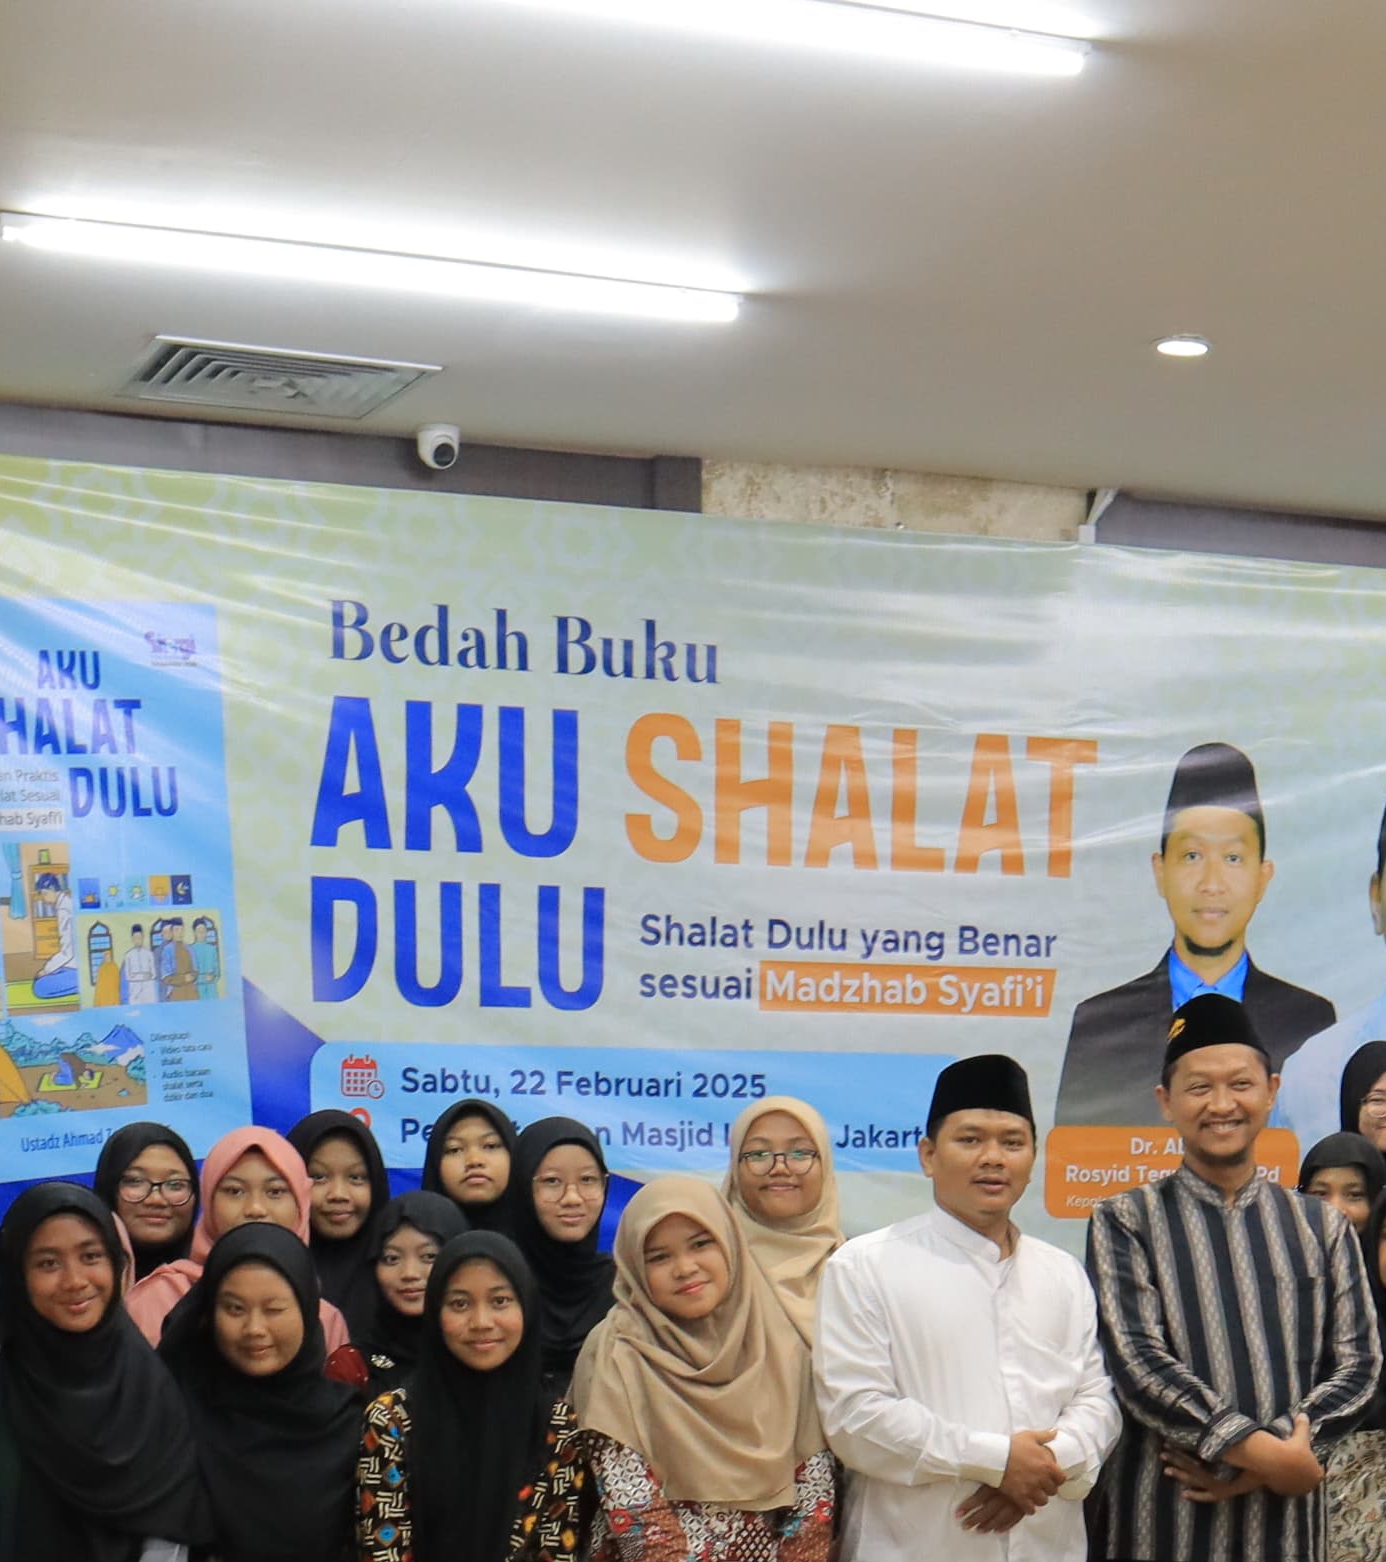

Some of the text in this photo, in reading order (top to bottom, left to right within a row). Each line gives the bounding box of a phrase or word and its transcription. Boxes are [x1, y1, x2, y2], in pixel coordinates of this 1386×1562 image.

[327, 599, 720, 685] Bedah Buku
[37, 649, 102, 690] AKU
[14, 769, 59, 783] Praktis
[68, 766, 180, 819] DULU
[309, 695, 1099, 879] AKU SHALAT
[19, 787, 61, 802] Sesuai
[310, 875, 607, 1012] DULU
[639, 914, 1058, 960] Shalat Dulu yang Benar
[639, 968, 754, 1001] sesuai
[765, 968, 928, 1007] Madzhab
[400, 1066, 767, 1099] Sabtu, 22 Februari 2025
[20, 1134, 60, 1152] Ustadz
[62, 1128, 103, 1146] Ahmad
[621, 1121, 714, 1153] Masjid
[835, 1124, 923, 1149] Jakart
[1130, 1137, 1158, 1155] Dr.
[1065, 1164, 1130, 1187] Rosyid
